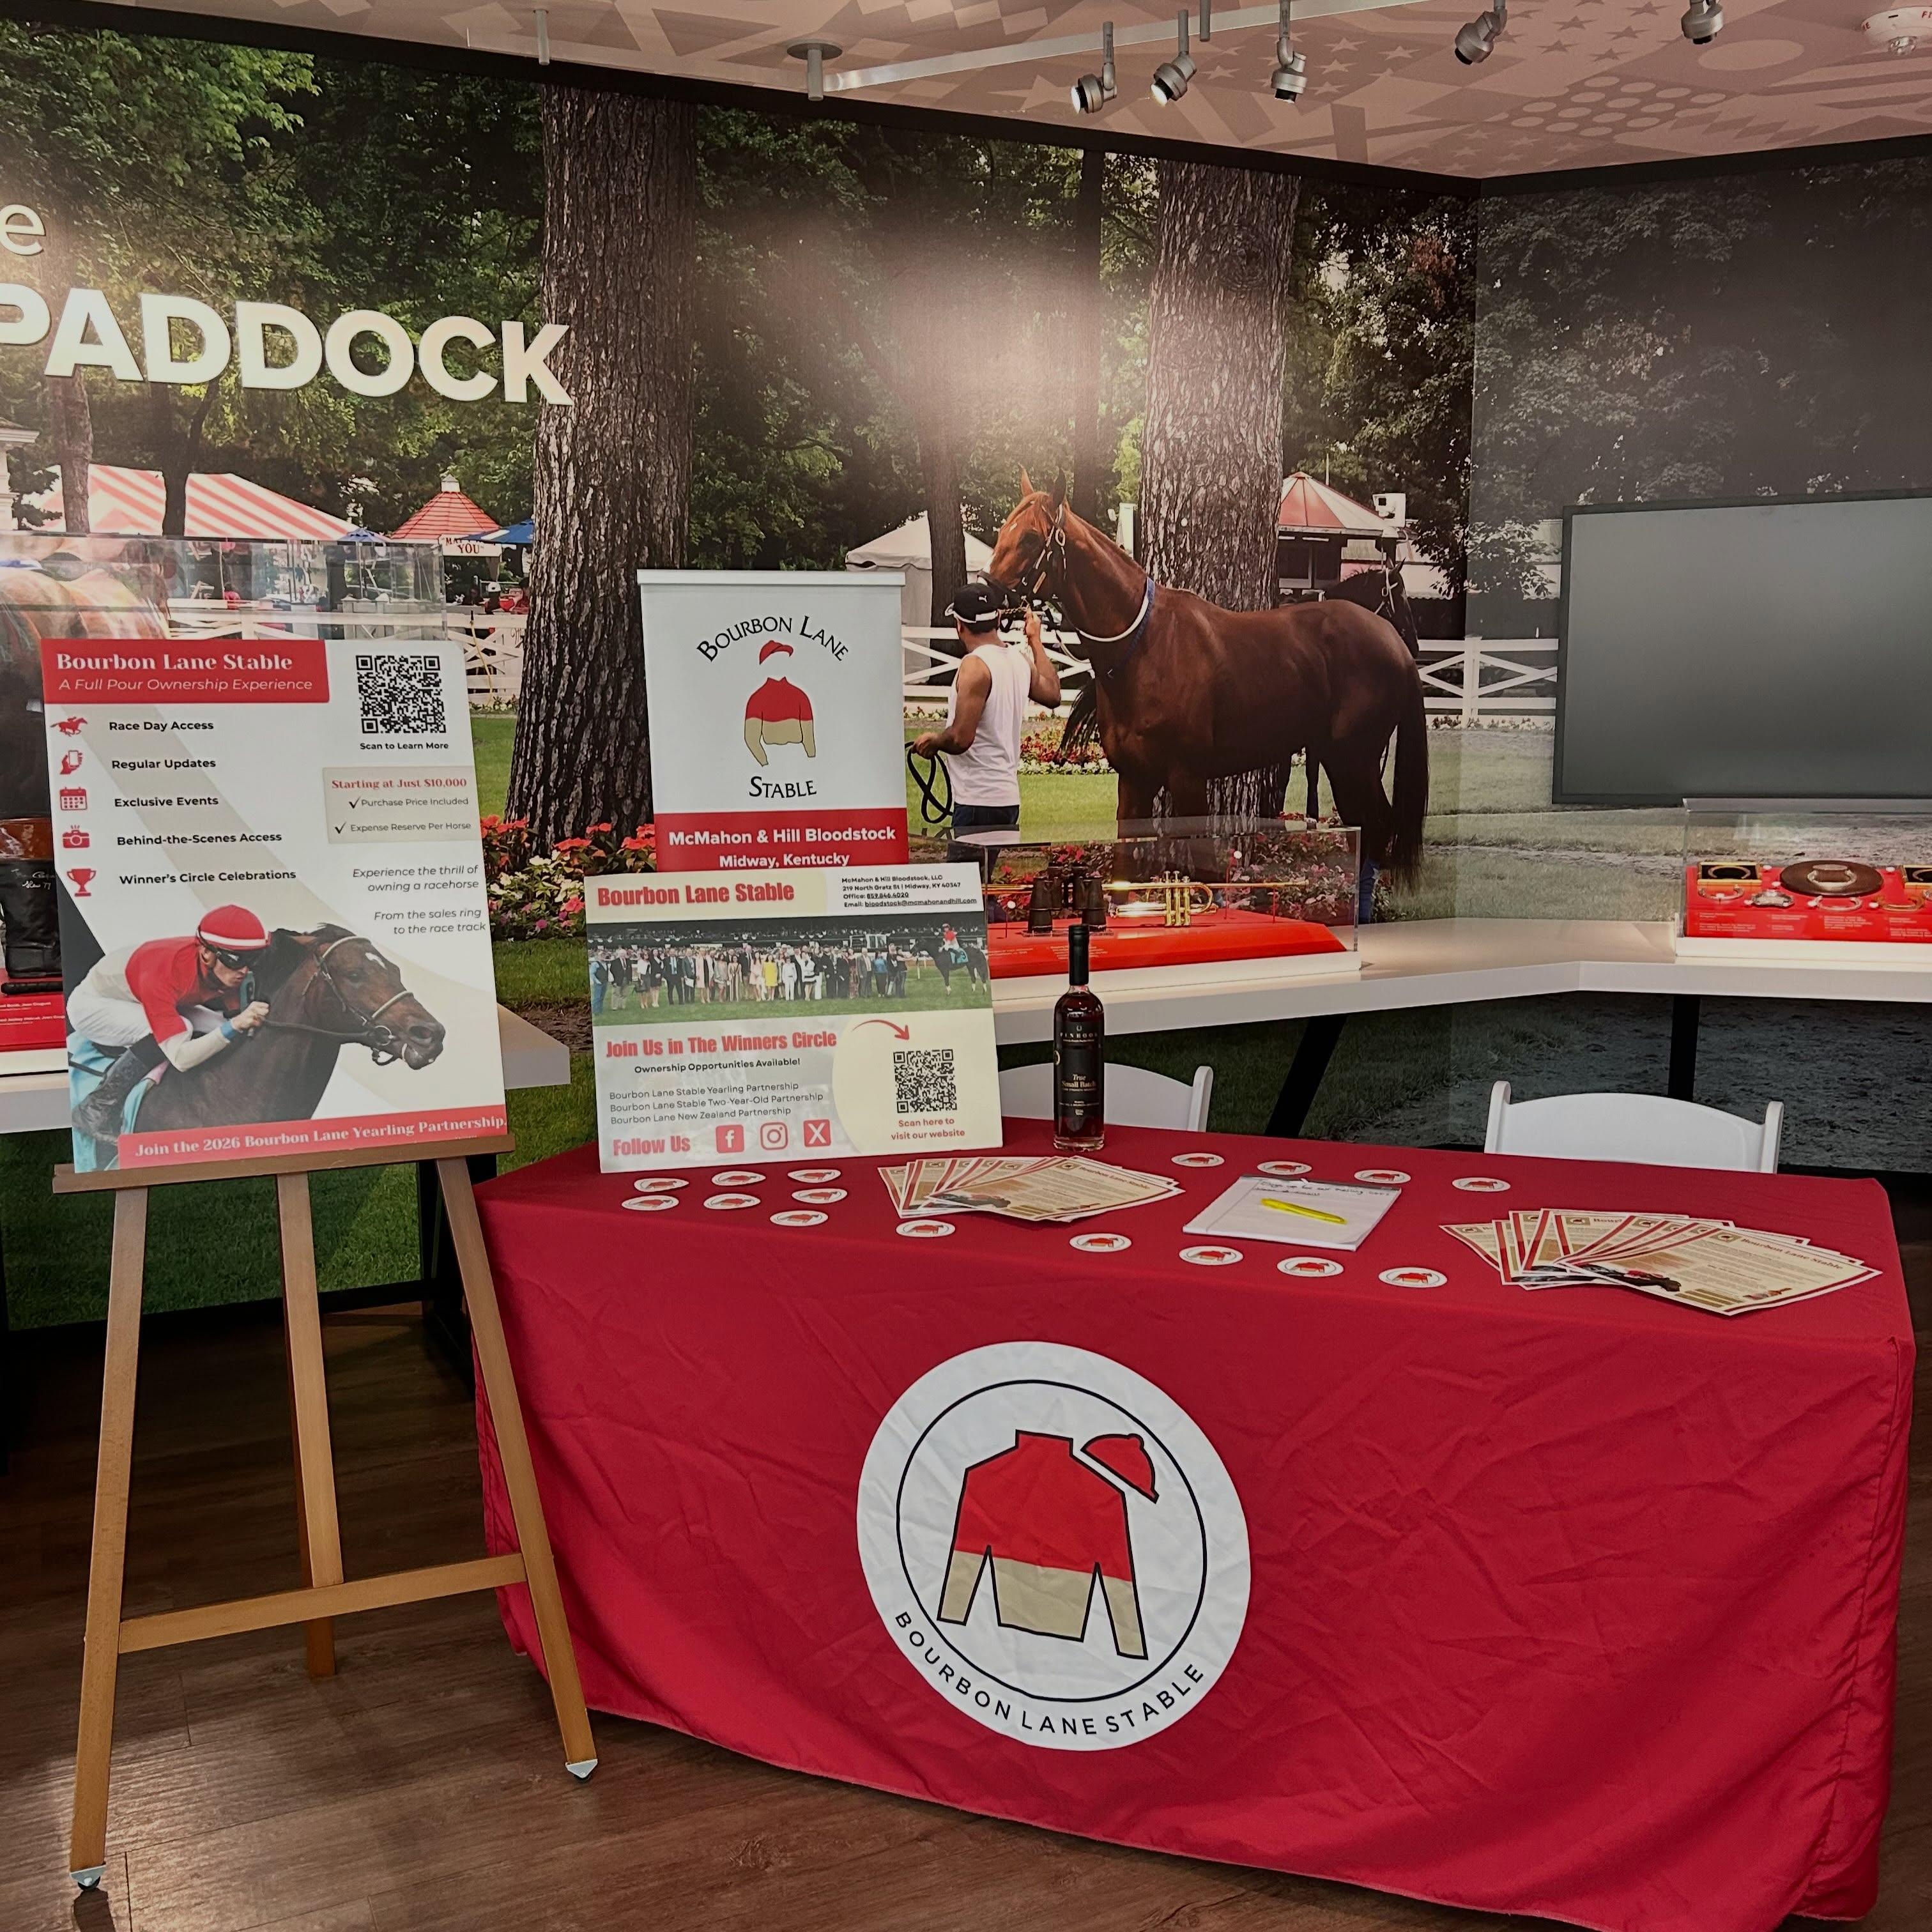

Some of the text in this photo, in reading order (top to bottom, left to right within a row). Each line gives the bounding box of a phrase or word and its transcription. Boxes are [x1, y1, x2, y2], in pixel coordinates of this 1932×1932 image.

[696, 615, 849, 663] BOURBON LANE
[56, 653, 293, 670] Bourbon Lane Stable
[58, 678, 312, 692] A Full Pour Ownership Experience
[109, 721, 214, 732] Race Day Access
[360, 741, 449, 751] Scan to Learn More
[112, 758, 217, 771] Regular Updates
[332, 778, 468, 792] Starting at Just $10,000
[749, 776, 817, 799] STABLE
[114, 796, 219, 808] Exclusive Events
[361, 796, 469, 807] Purchase Price Included
[350, 821, 471, 834] Expense Reserve Per Horse
[117, 832, 282, 847] Behind-the-Scenes Access
[669, 826, 896, 846] McMahon & Hill Bloodstock
[719, 852, 850, 869] Midway, Kentucky
[180, 871, 215, 882] Circle
[218, 870, 296, 882] Celebrations
[353, 864, 479, 880] Experience the thrill of
[367, 882, 411, 893] owning
[423, 879, 479, 891] racehorse
[598, 882, 795, 907] Bourbon Lane Stable
[374, 907, 482, 921] From the sales ring
[394, 921, 486, 935] to the race track
[606, 1031, 837, 1058] Join Us in The Winners Circle
[634, 1058, 800, 1074] Ownership Opportunities Available!
[610, 1082, 799, 1100] Bourbon Lane Stable Yearling Partnership
[610, 1092, 824, 1112] Bourbon Lane Stable Two-Year-Old Partnership
[611, 1107, 792, 1124] Bourbon Lane New Zealand Partnership
[135, 1142, 170, 1158] Join
[173, 1139, 201, 1154] the
[203, 1136, 241, 1151] 2026
[245, 1133, 310, 1149] Bourbon
[313, 1129, 350, 1143] Lane
[353, 1124, 415, 1140] Yearling
[891, 1131, 910, 1140] visit
[929, 1129, 965, 1138] website
[613, 1135, 691, 1156] Follow Us
[896, 1612, 1204, 1735] BOURBON LANE STABLE
